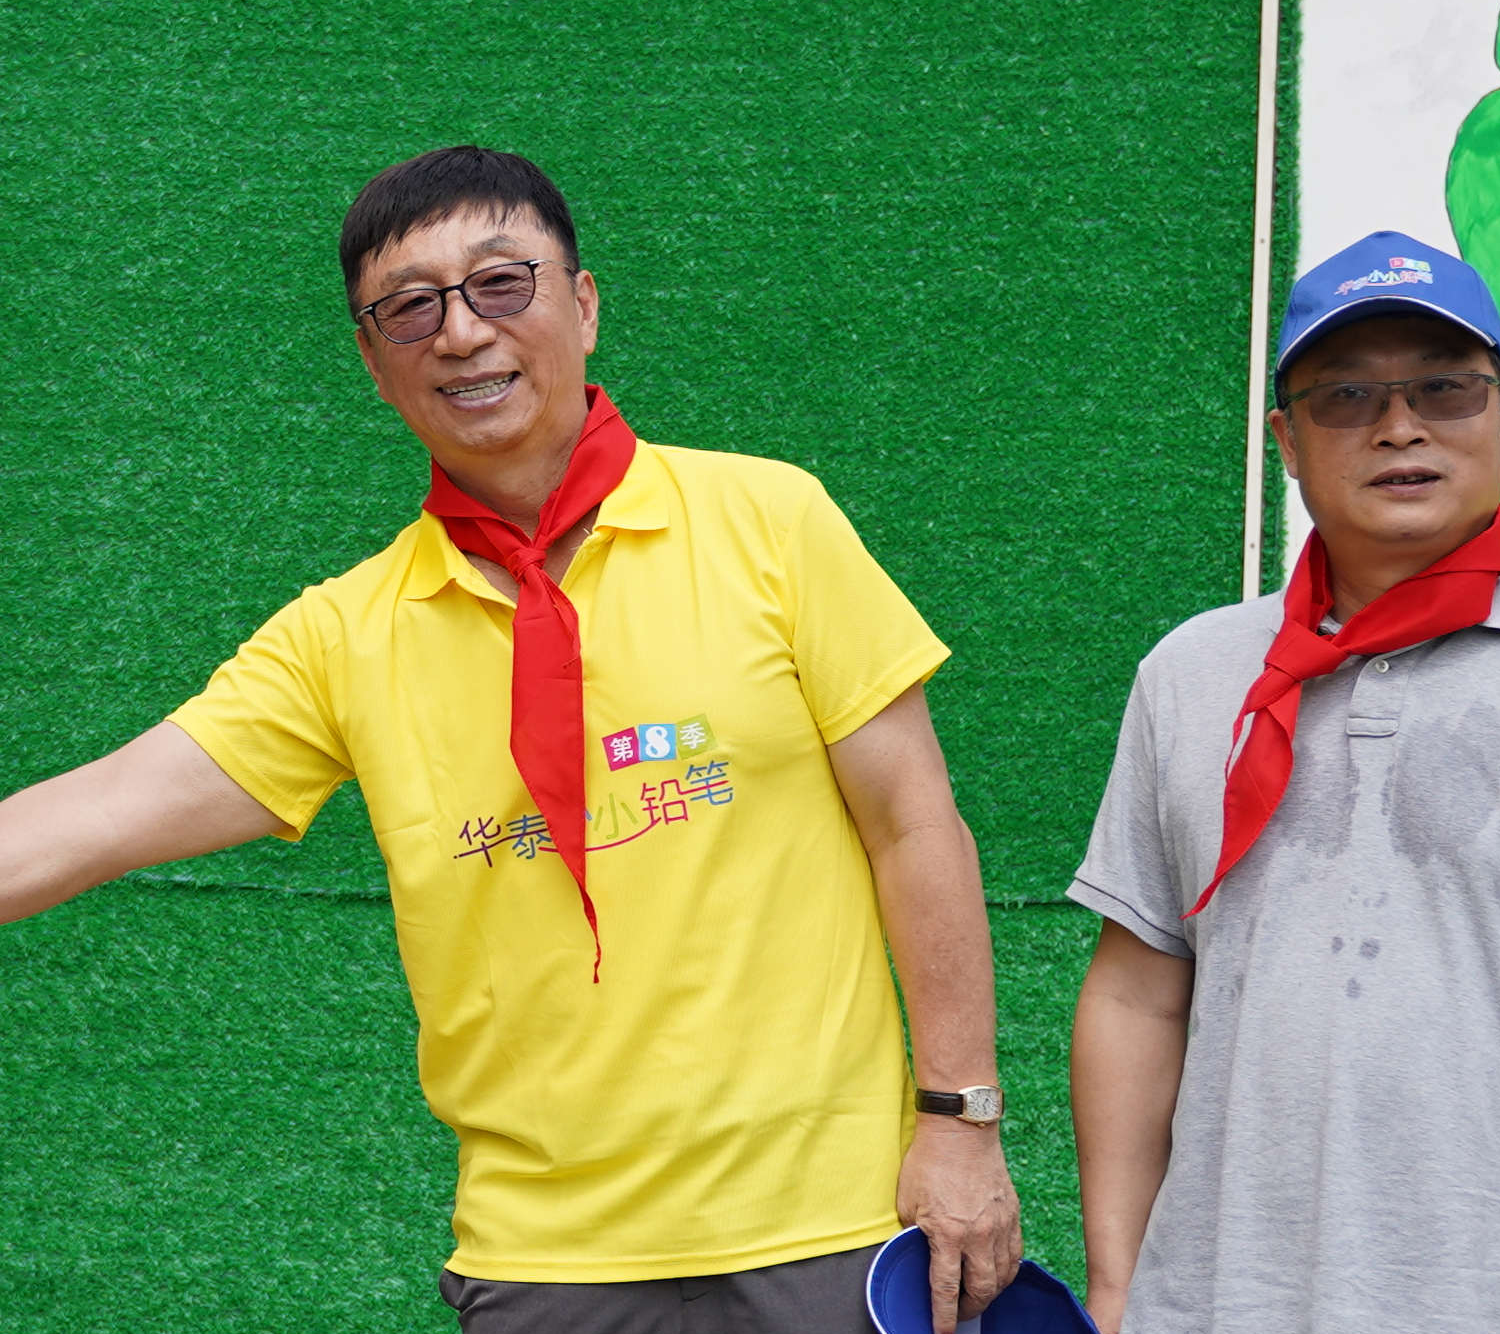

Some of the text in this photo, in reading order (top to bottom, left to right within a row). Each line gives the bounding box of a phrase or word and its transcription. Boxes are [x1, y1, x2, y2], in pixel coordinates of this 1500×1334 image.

[608, 722, 707, 763] 第8季
[453, 760, 734, 868] 华泰小铅笔
